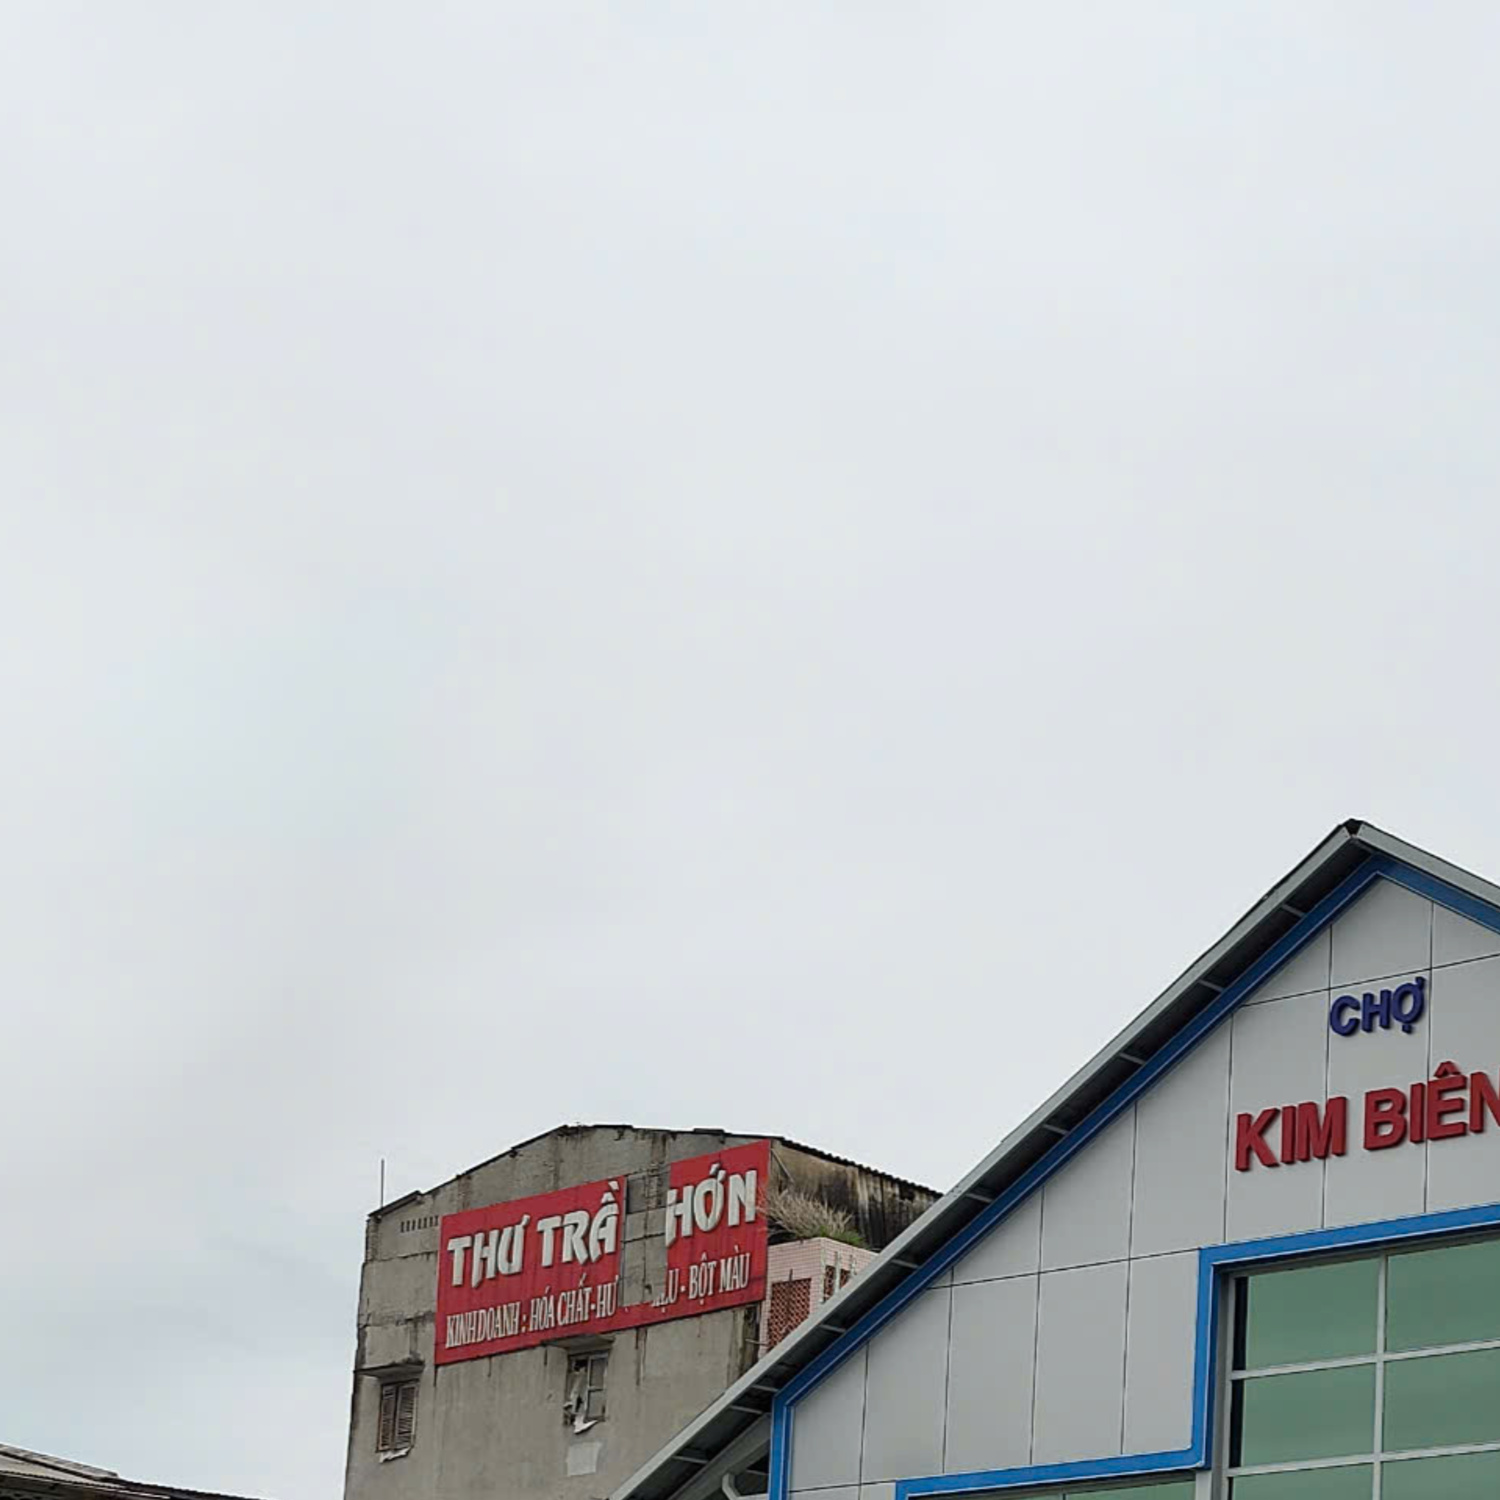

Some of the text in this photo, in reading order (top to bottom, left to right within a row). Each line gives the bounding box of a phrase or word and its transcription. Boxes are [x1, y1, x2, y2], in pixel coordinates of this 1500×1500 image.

[1329, 976, 1427, 1037] CHỢ
[1235, 1096, 1349, 1172] KIM
[536, 1180, 620, 1265] TRẦ
[688, 1252, 717, 1305] BỘT
[718, 1244, 752, 1294] MÀU
